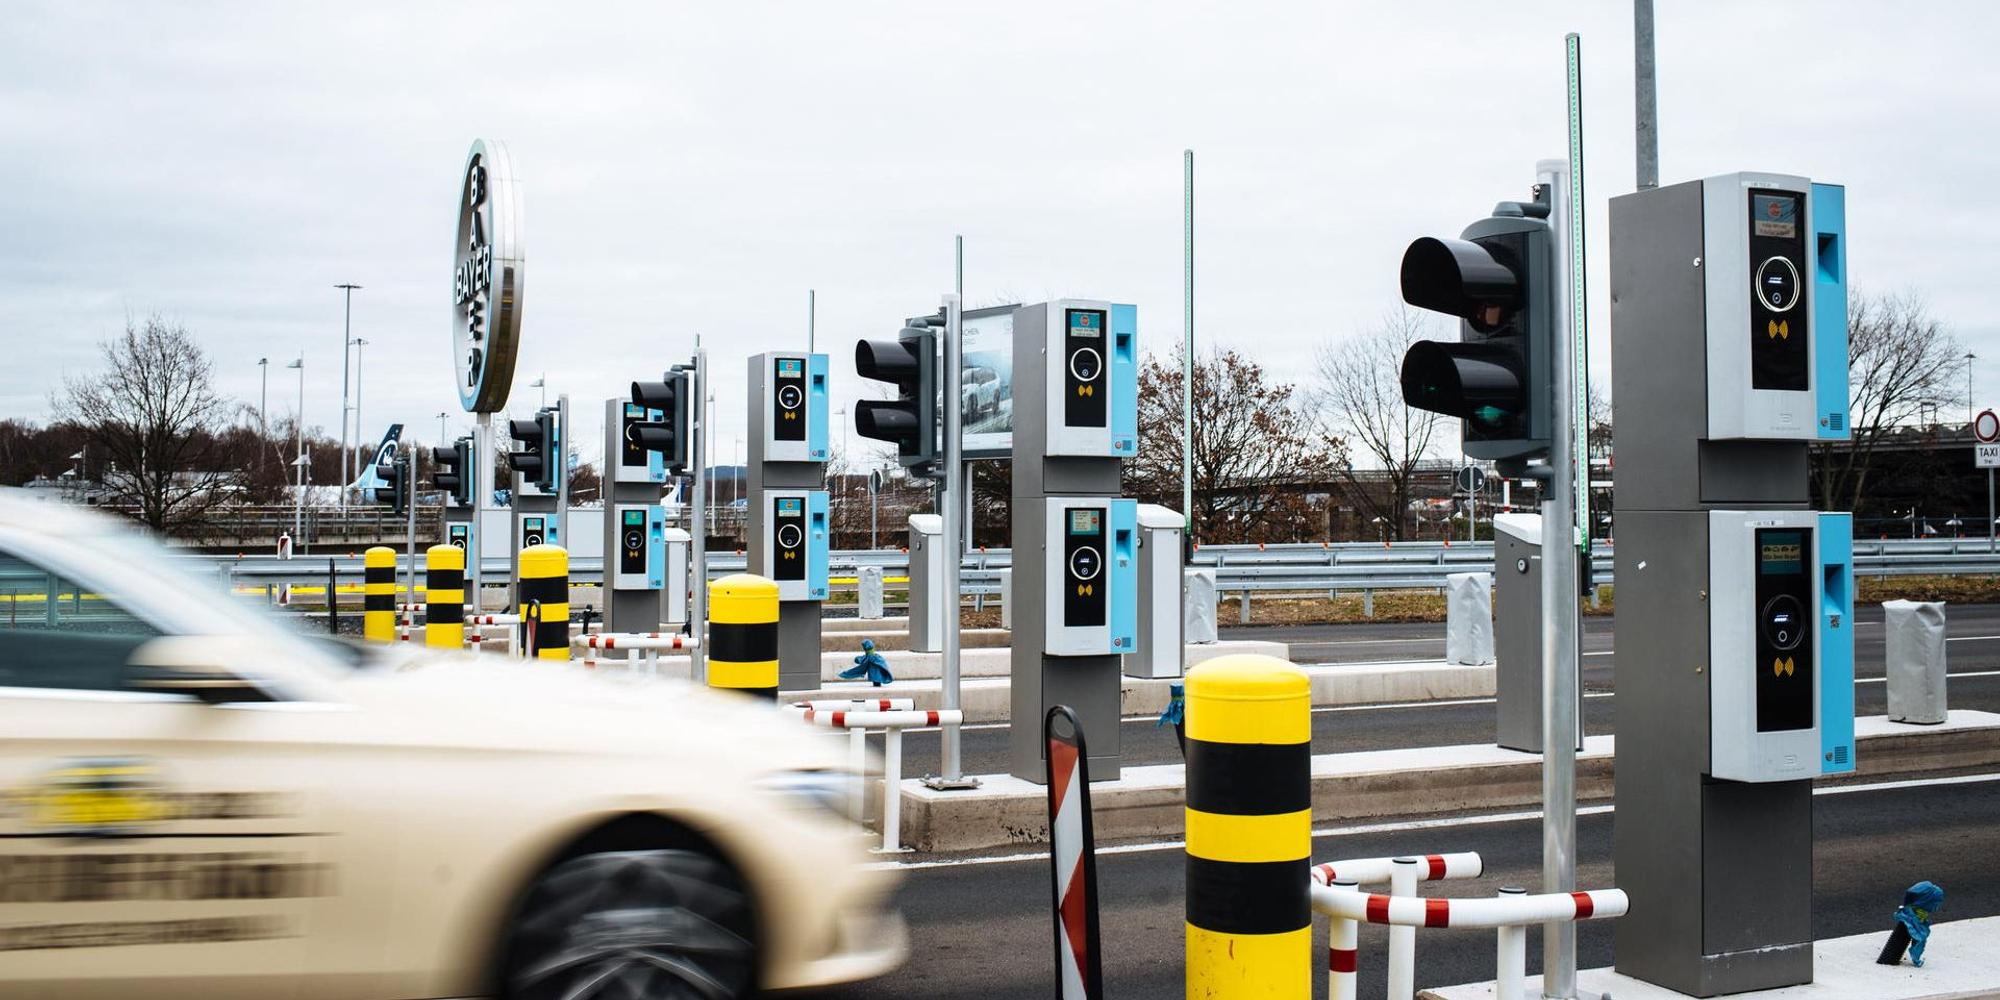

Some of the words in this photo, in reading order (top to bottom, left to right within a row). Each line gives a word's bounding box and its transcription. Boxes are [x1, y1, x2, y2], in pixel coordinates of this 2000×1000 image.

[456, 246, 491, 304] BAYER
[467, 165, 486, 387] BAYER
[1979, 447, 1999, 457] TAXI
